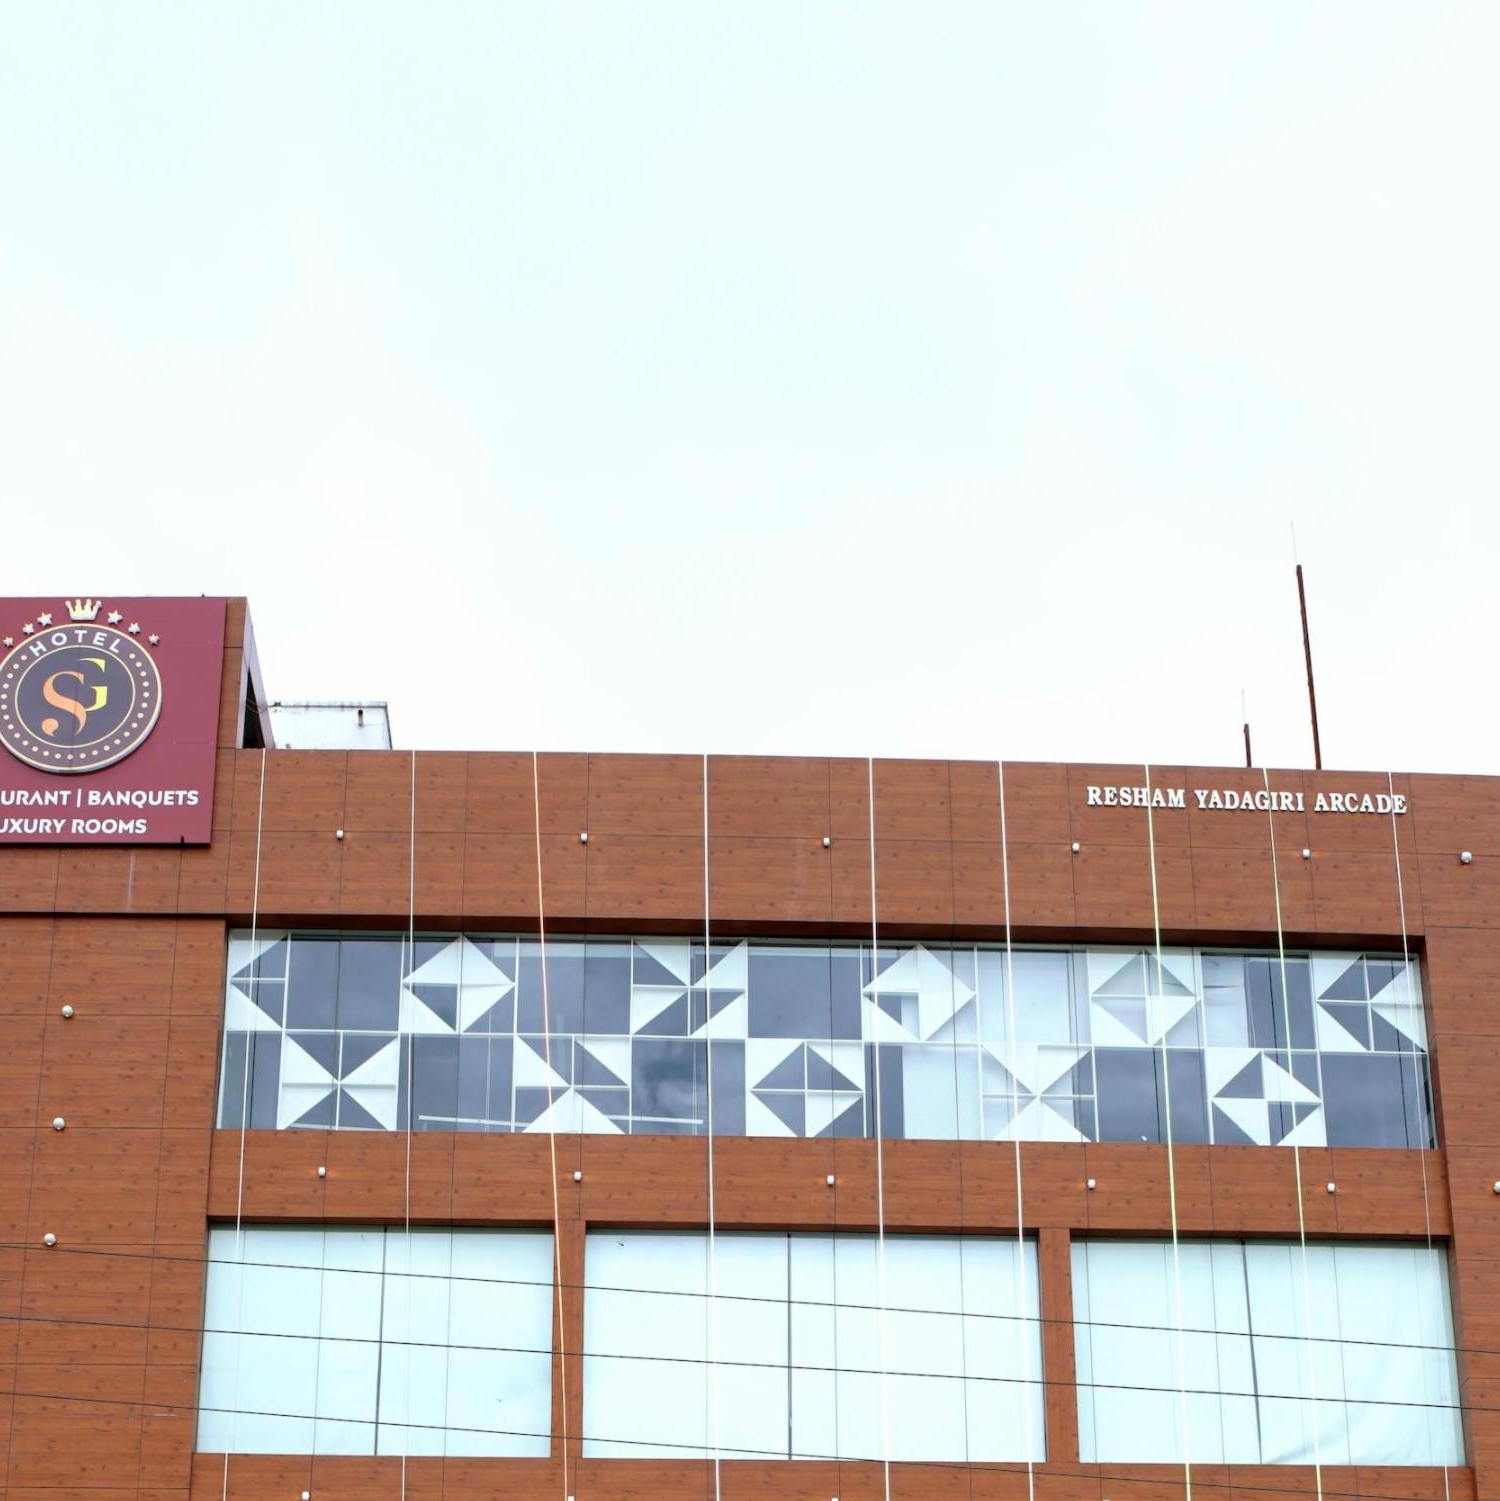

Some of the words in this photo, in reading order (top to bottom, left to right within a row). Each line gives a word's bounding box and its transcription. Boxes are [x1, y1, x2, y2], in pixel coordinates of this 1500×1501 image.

[29, 629, 120, 657] HOTEL
[88, 790, 199, 808] BANQUETS
[1087, 786, 1185, 808] RESHAM
[1194, 790, 1305, 812] YADAGIRI
[1314, 792, 1407, 815] ARCADE
[71, 818, 148, 834] ROOMS
